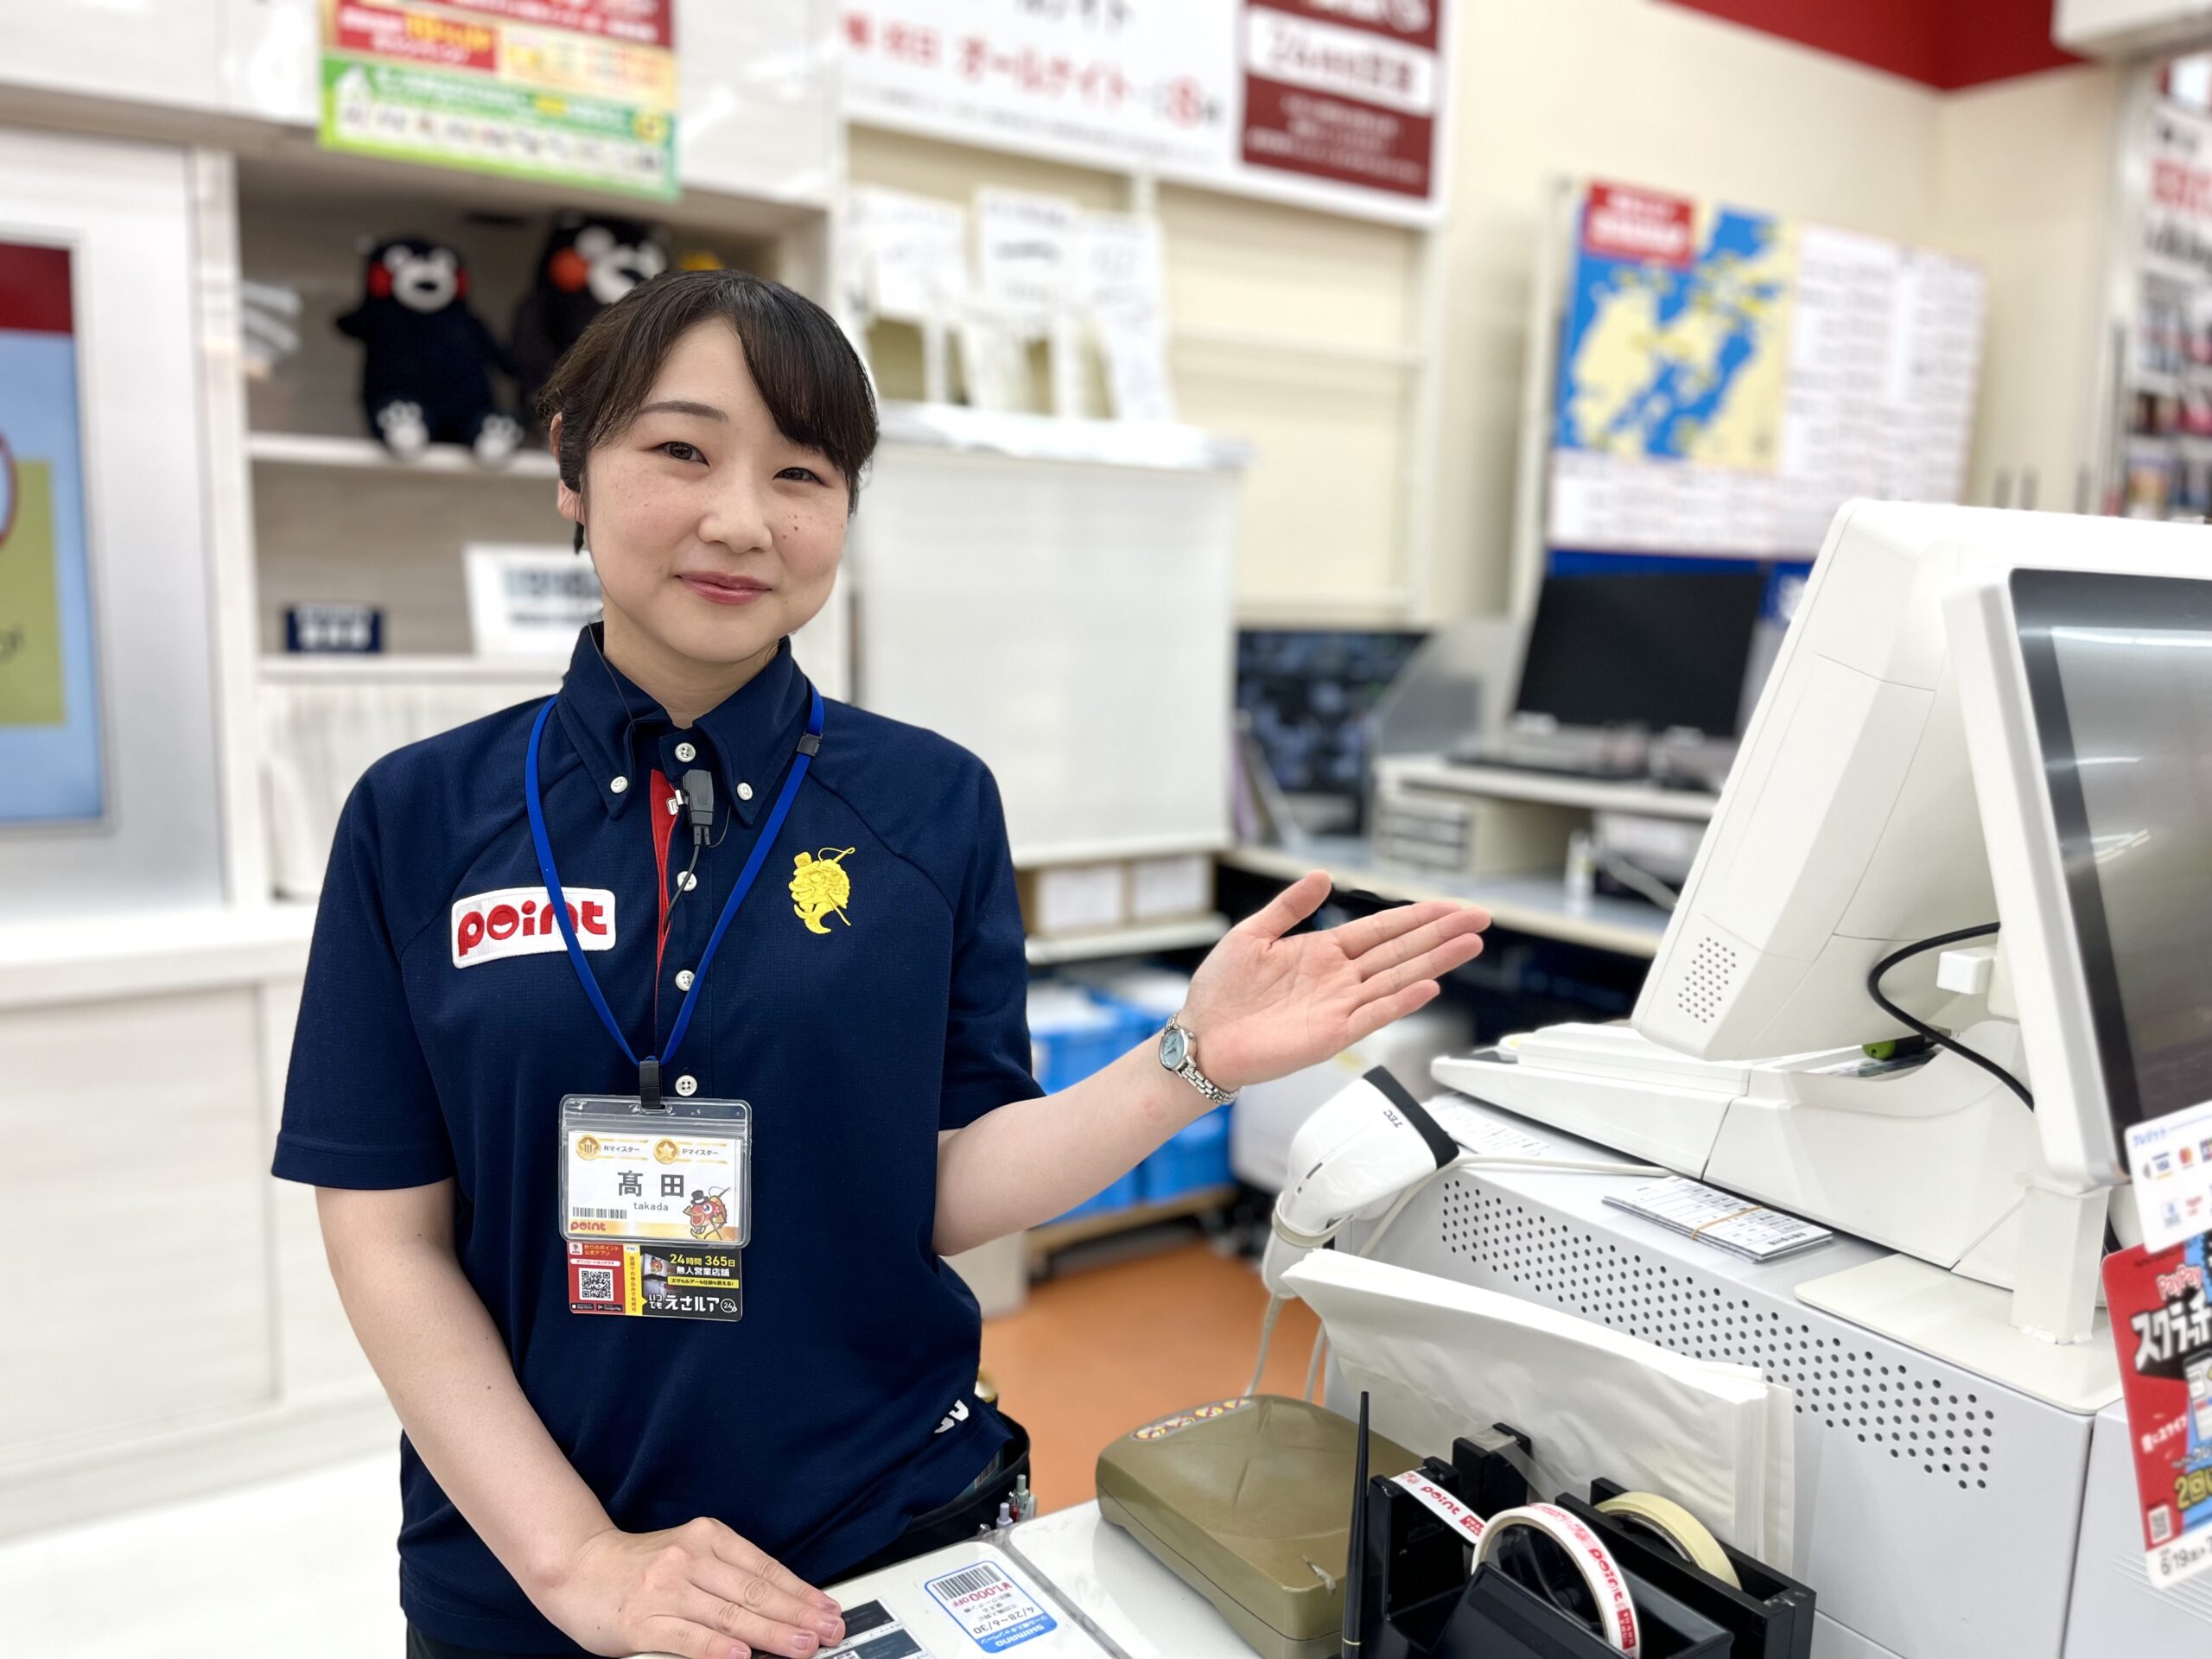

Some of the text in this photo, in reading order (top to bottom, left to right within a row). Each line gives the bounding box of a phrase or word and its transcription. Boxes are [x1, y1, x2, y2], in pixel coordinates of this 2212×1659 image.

[458, 900, 607, 957] point
[1382, 1109, 1403, 1128] TEC
[633, 1201, 669, 1211] takada
[570, 1221, 607, 1231] point
[704, 1255, 735, 1267] 365日
[676, 1266, 730, 1277] 無人営業店舗
[2157, 1264, 2201, 1300] PayPay
[664, 1294, 720, 1312] えさルア
[1420, 1486, 1460, 1515] point
[1589, 1548, 1622, 1601] point
[995, 1624, 1045, 1647] SHIMANO
